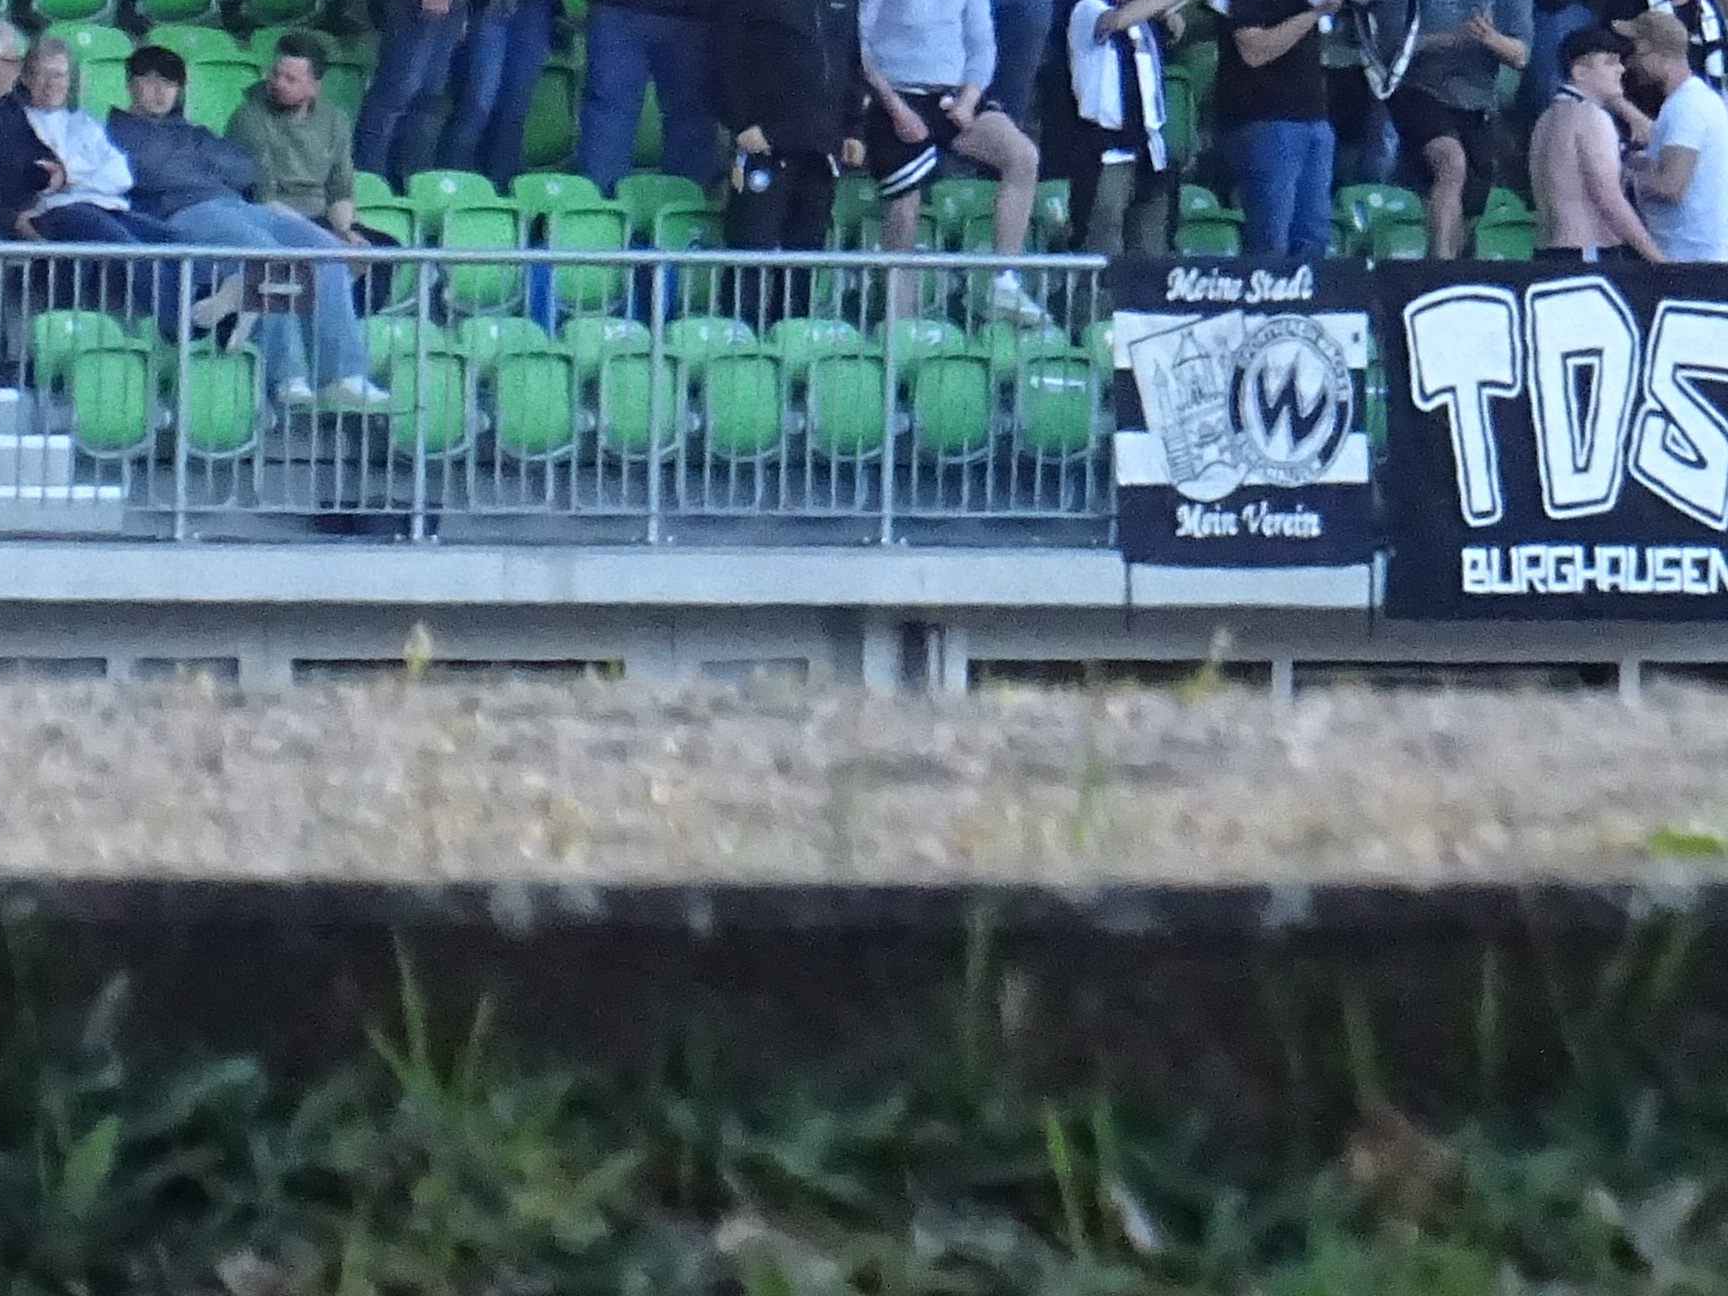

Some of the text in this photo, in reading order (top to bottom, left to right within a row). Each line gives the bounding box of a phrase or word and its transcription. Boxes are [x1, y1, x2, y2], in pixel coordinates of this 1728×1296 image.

[1244, 264, 1314, 304] Stadt
[1174, 499, 1323, 540] Mein Verein
